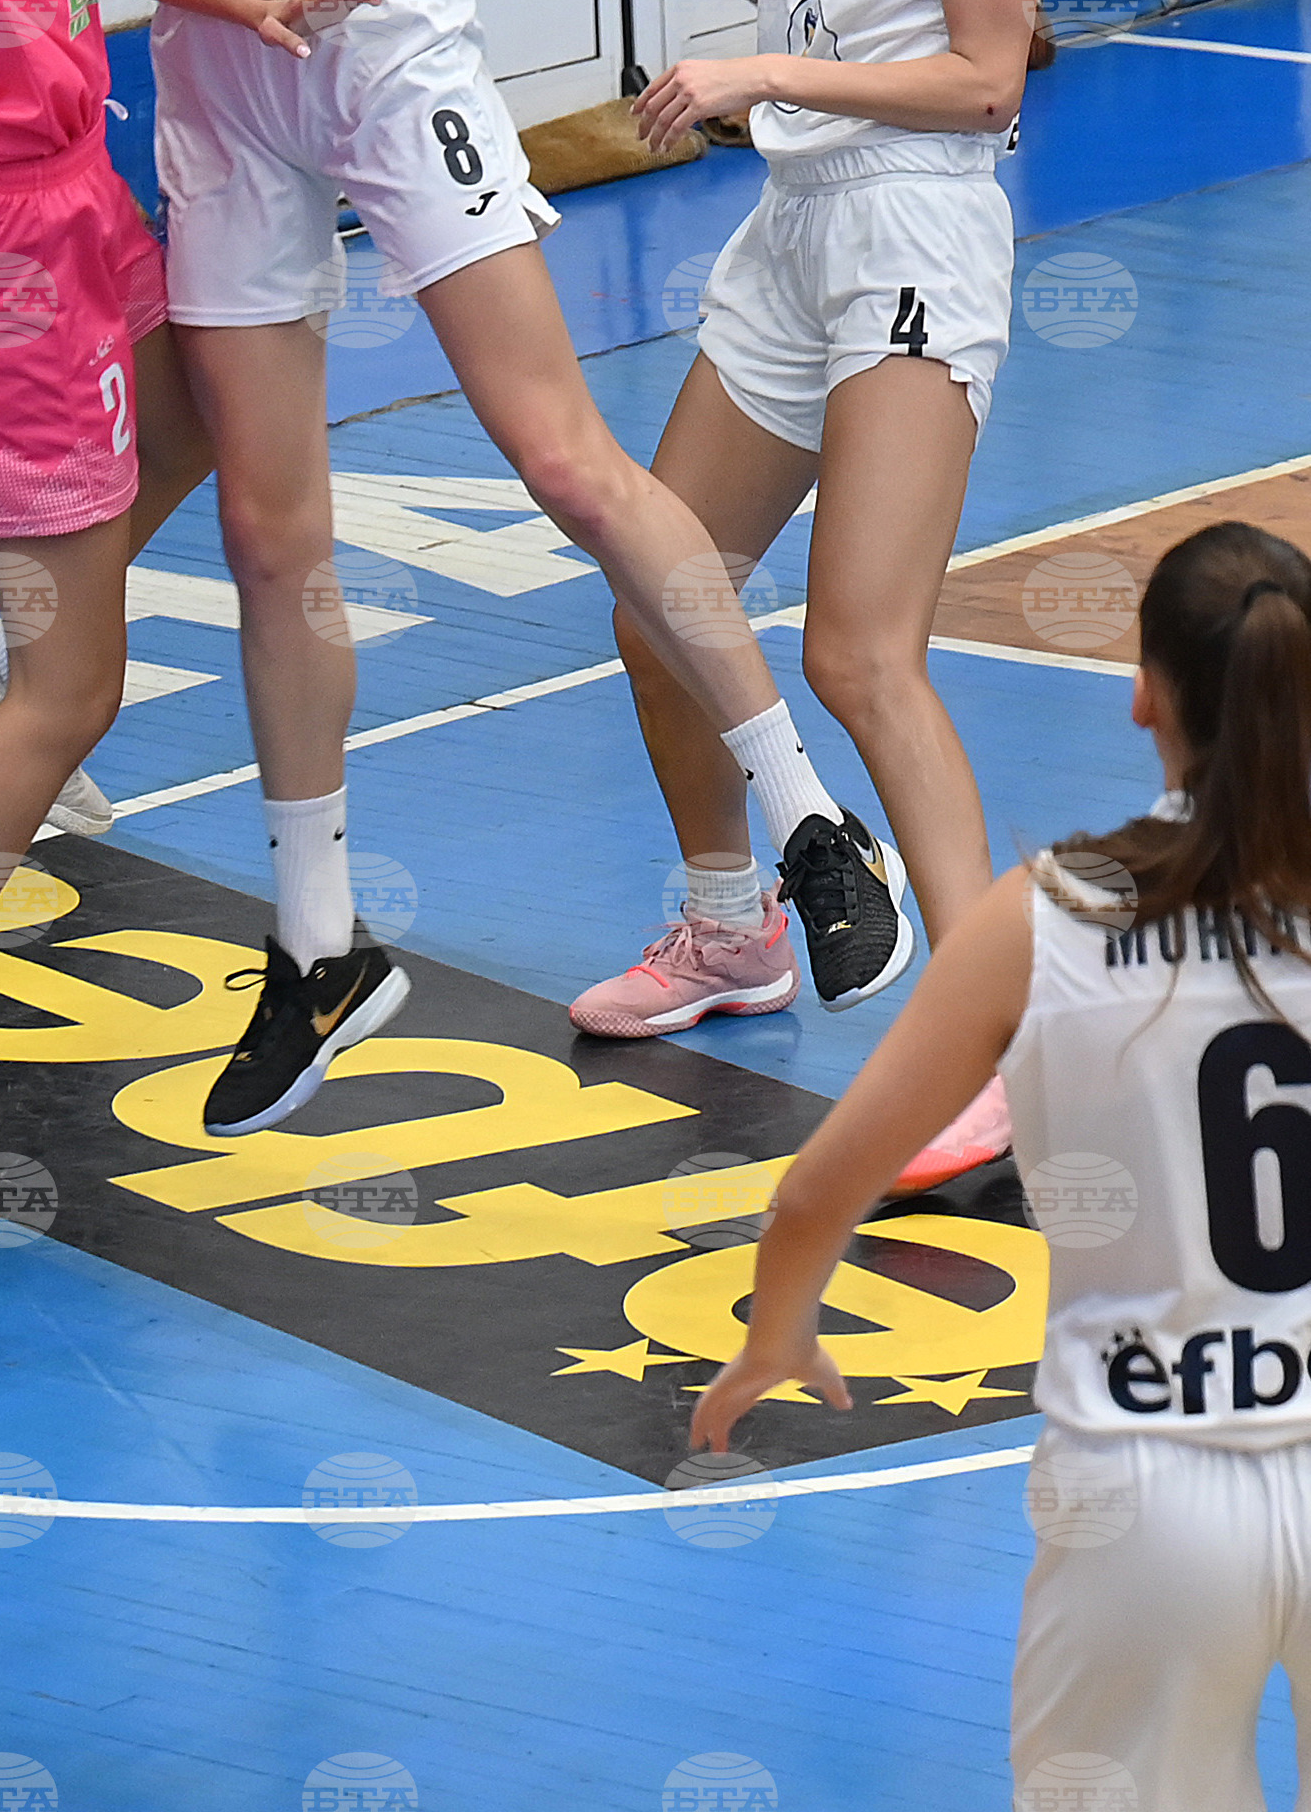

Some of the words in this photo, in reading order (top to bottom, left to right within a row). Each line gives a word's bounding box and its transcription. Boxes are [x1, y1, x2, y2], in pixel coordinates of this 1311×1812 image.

[432, 109, 483, 185] 8
[890, 287, 928, 356] 4
[99, 362, 131, 456] 2
[1197, 1022, 1311, 1293] 6
[1105, 1327, 1311, 1416] efb
